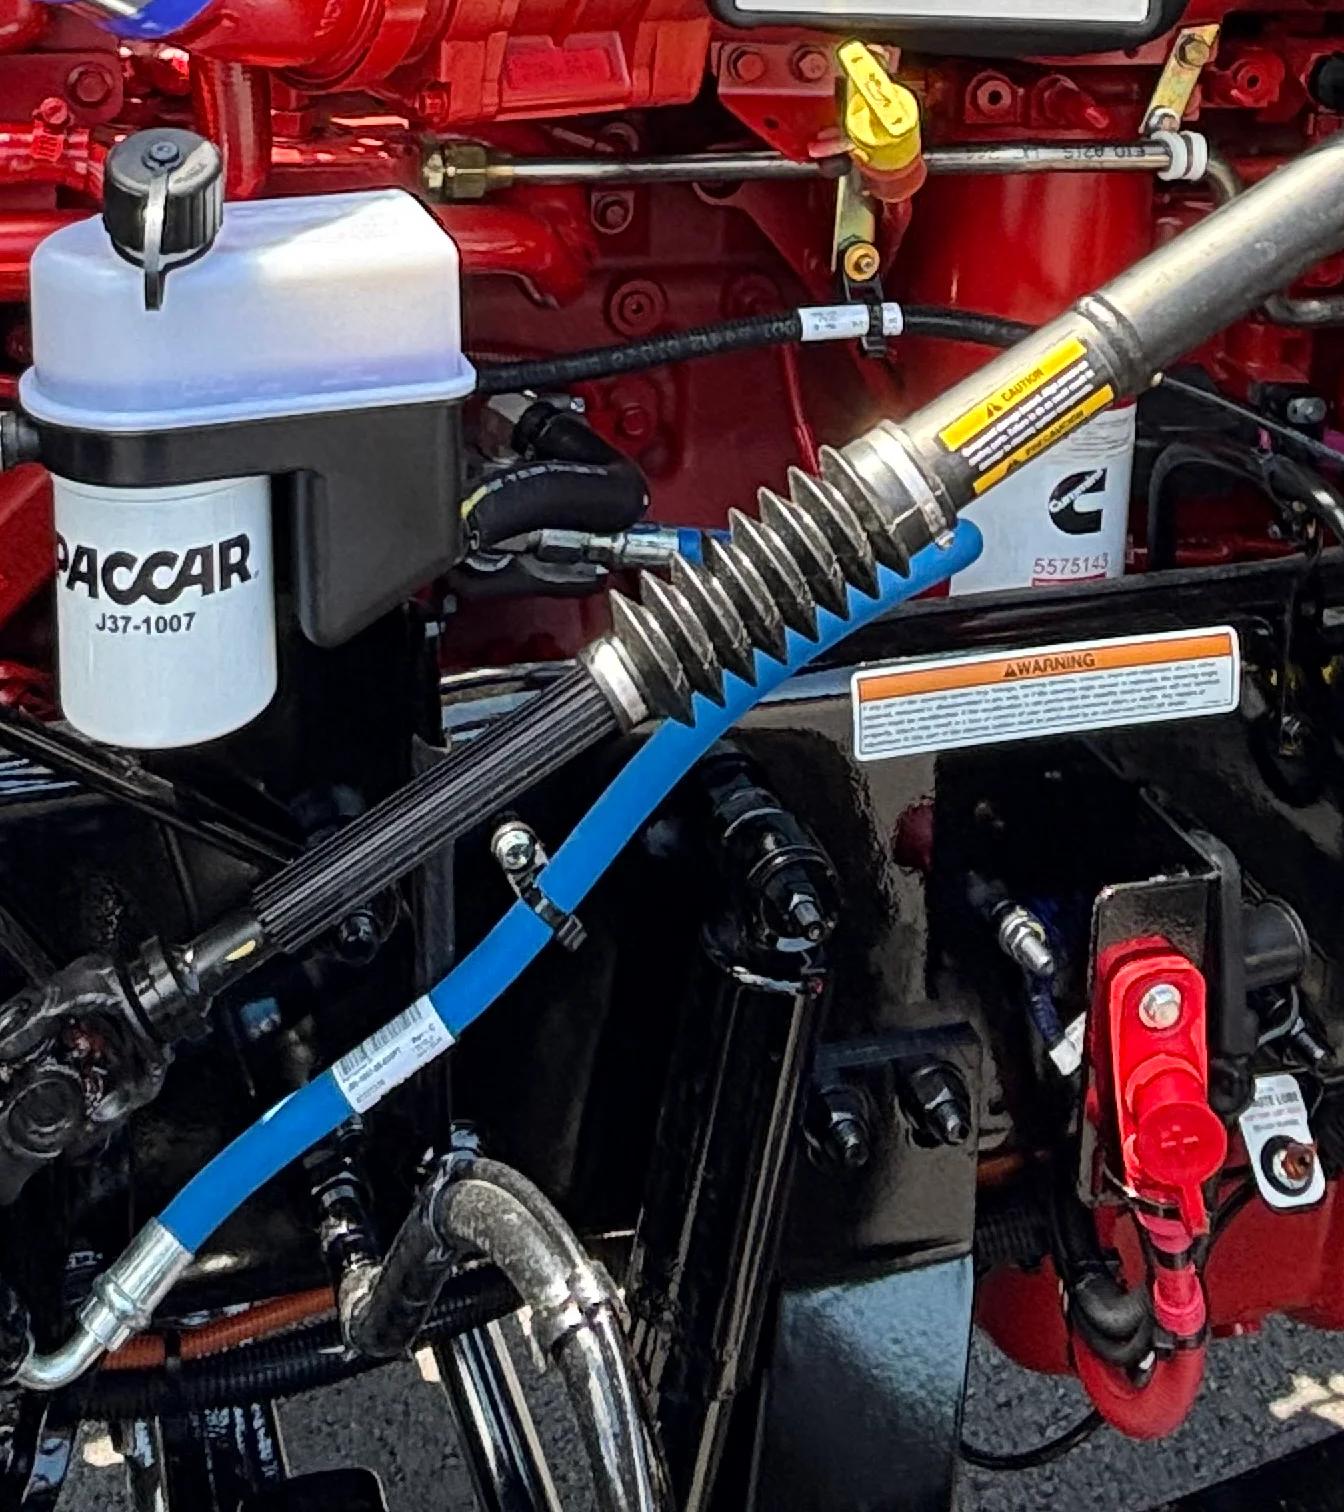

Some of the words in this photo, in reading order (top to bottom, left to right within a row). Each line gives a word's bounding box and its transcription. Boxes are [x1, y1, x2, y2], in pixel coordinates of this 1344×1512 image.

[1001, 368, 1045, 401] CAUTION
[56, 531, 252, 605] PACCAR
[96, 611, 196, 635] J37-1007
[1017, 653, 1095, 676] WARNING
